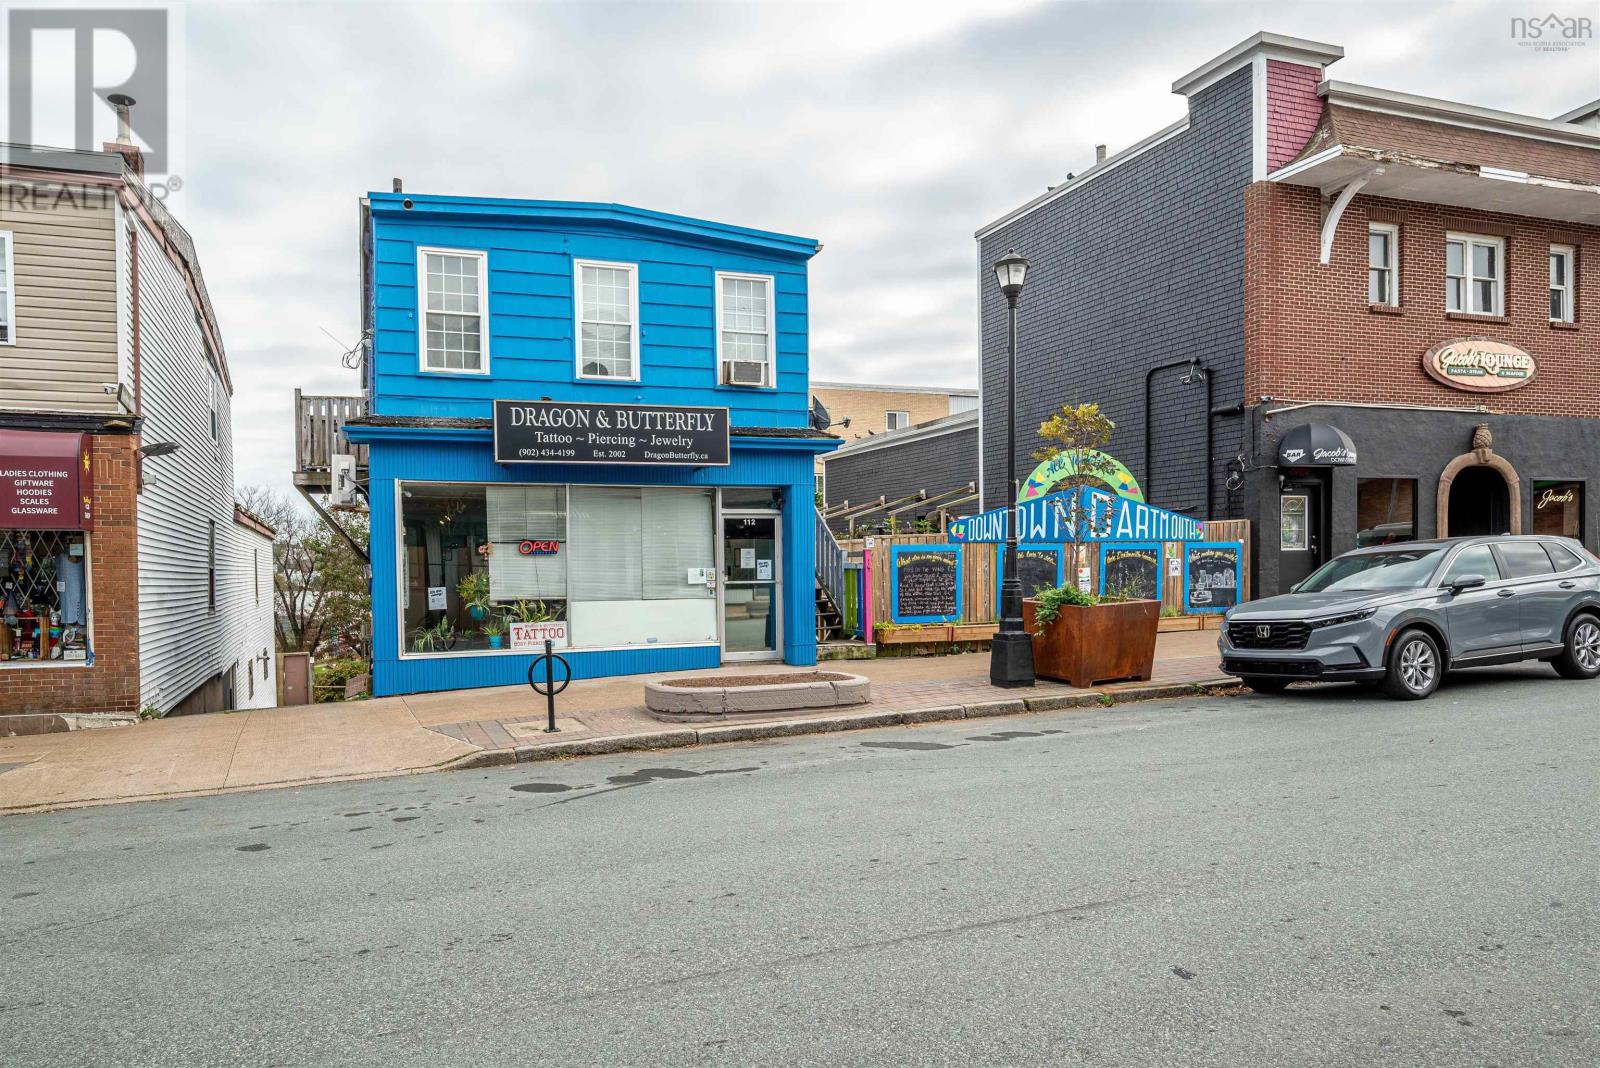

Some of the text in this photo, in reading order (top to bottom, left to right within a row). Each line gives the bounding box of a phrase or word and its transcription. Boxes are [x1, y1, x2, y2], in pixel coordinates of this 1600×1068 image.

[1479, 352, 1530, 374] LOUNGE
[510, 407, 715, 432] DRAGON & BUTTERFLY
[534, 432, 572, 444] Tattoo
[588, 433, 636, 448] Piercing
[650, 435, 693, 448] Jewelry
[518, 448, 539, 458] (902)
[540, 448, 575, 458] 434-4199
[608, 450, 626, 458] 2002
[644, 450, 708, 460] DragonButterfly.ca
[1313, 448, 1346, 460] Jacob's
[1538, 489, 1574, 509] Jacob's
[1090, 492, 1196, 540] DARTMOUTH
[518, 540, 560, 555] OPEN
[513, 628, 564, 640] TATTOO
